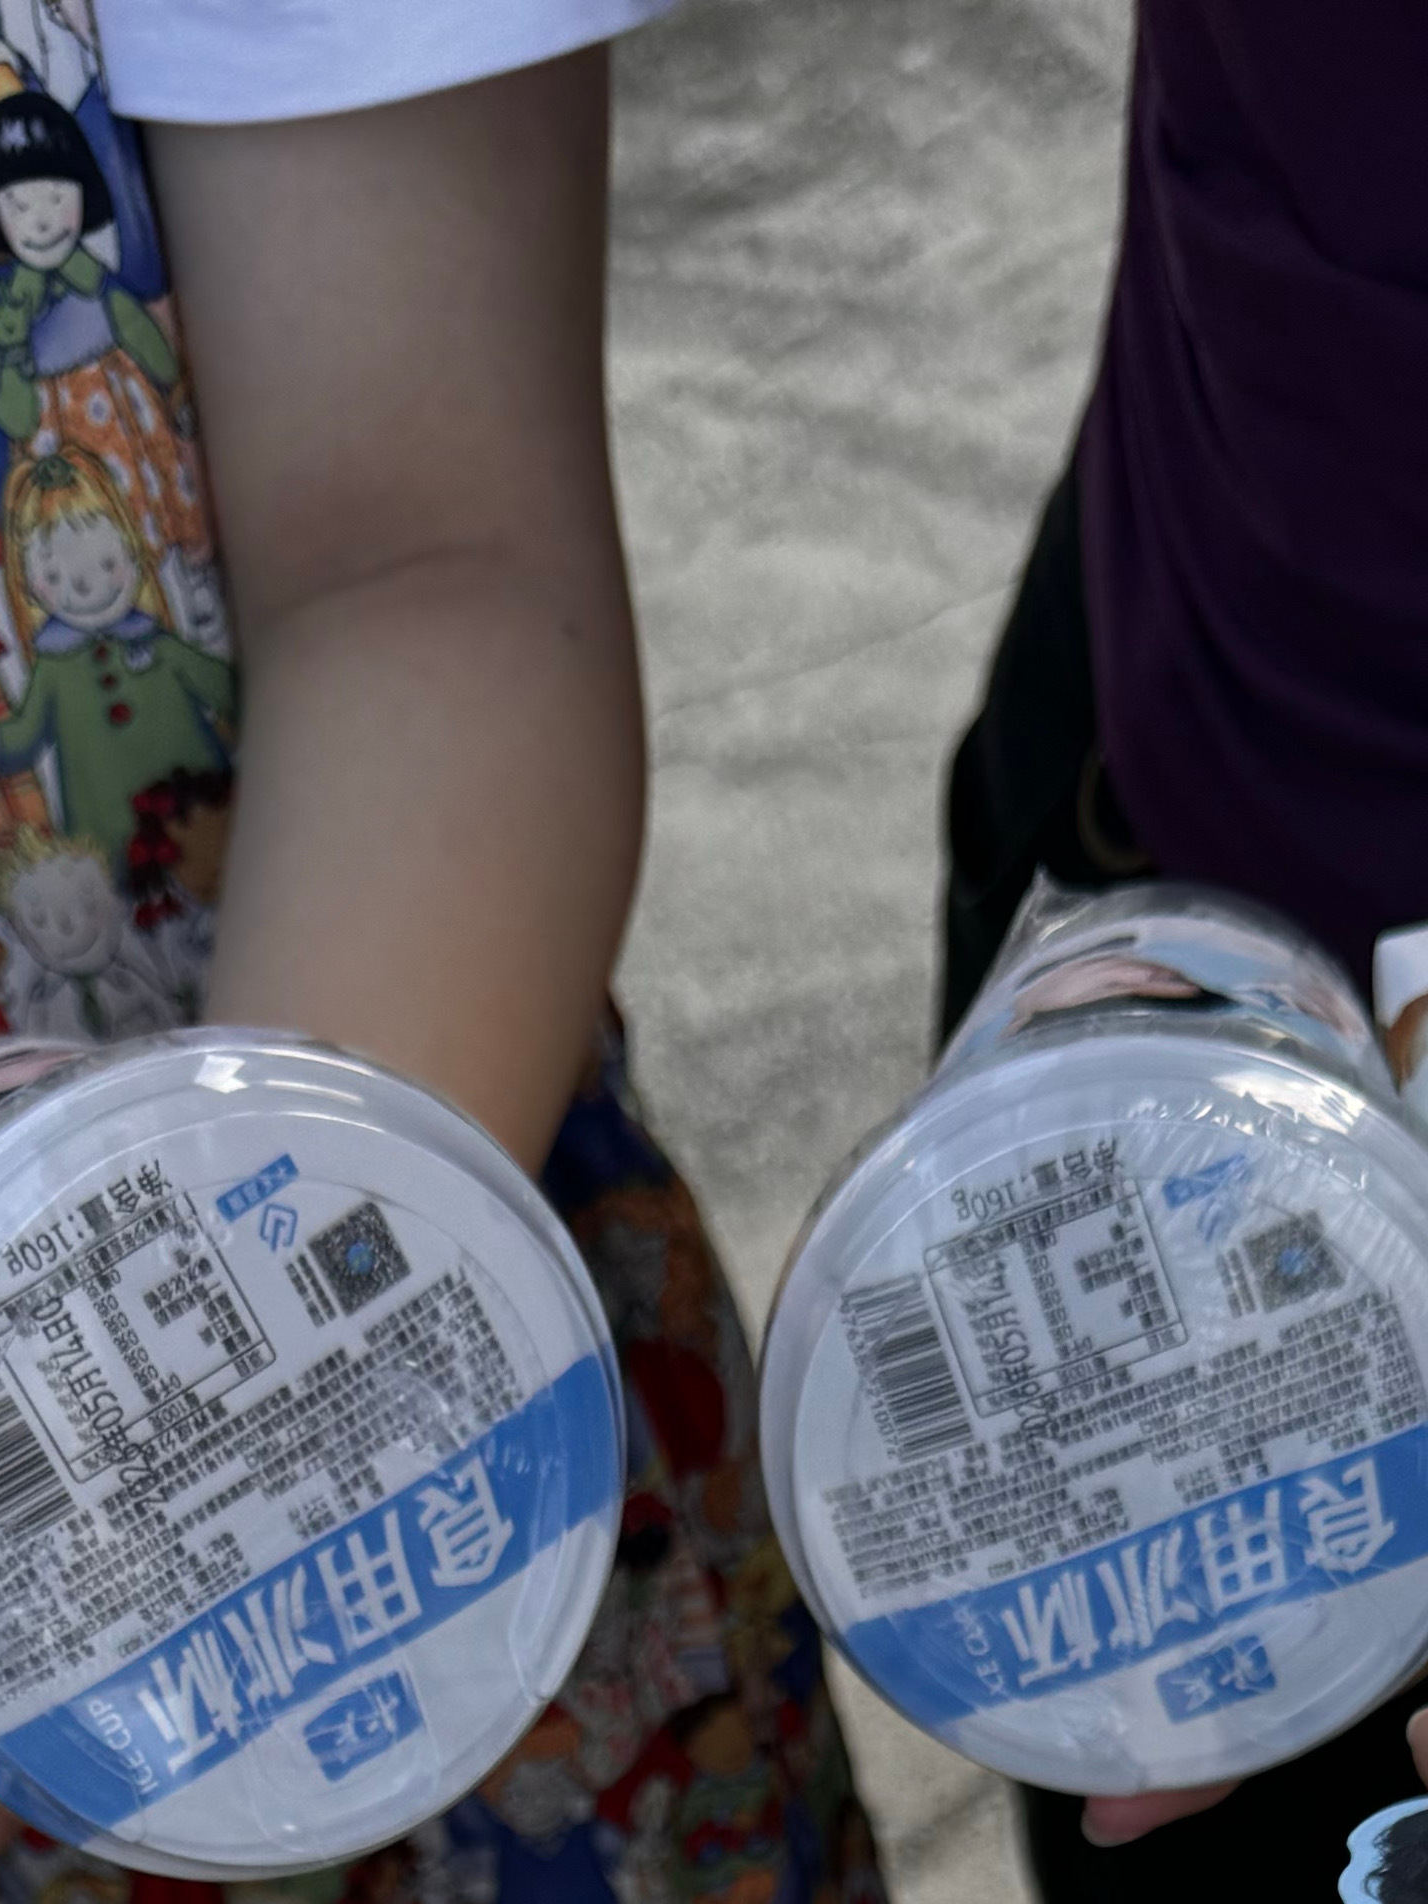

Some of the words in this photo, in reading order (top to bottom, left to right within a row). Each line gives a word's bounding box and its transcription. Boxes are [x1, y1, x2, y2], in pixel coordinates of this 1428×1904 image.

[142, 1460, 515, 1769] 食用冰杯
[1010, 1463, 1384, 1688] 食用冰杯
[85, 1692, 136, 1753] CUP
[119, 1746, 164, 1797] ICE
